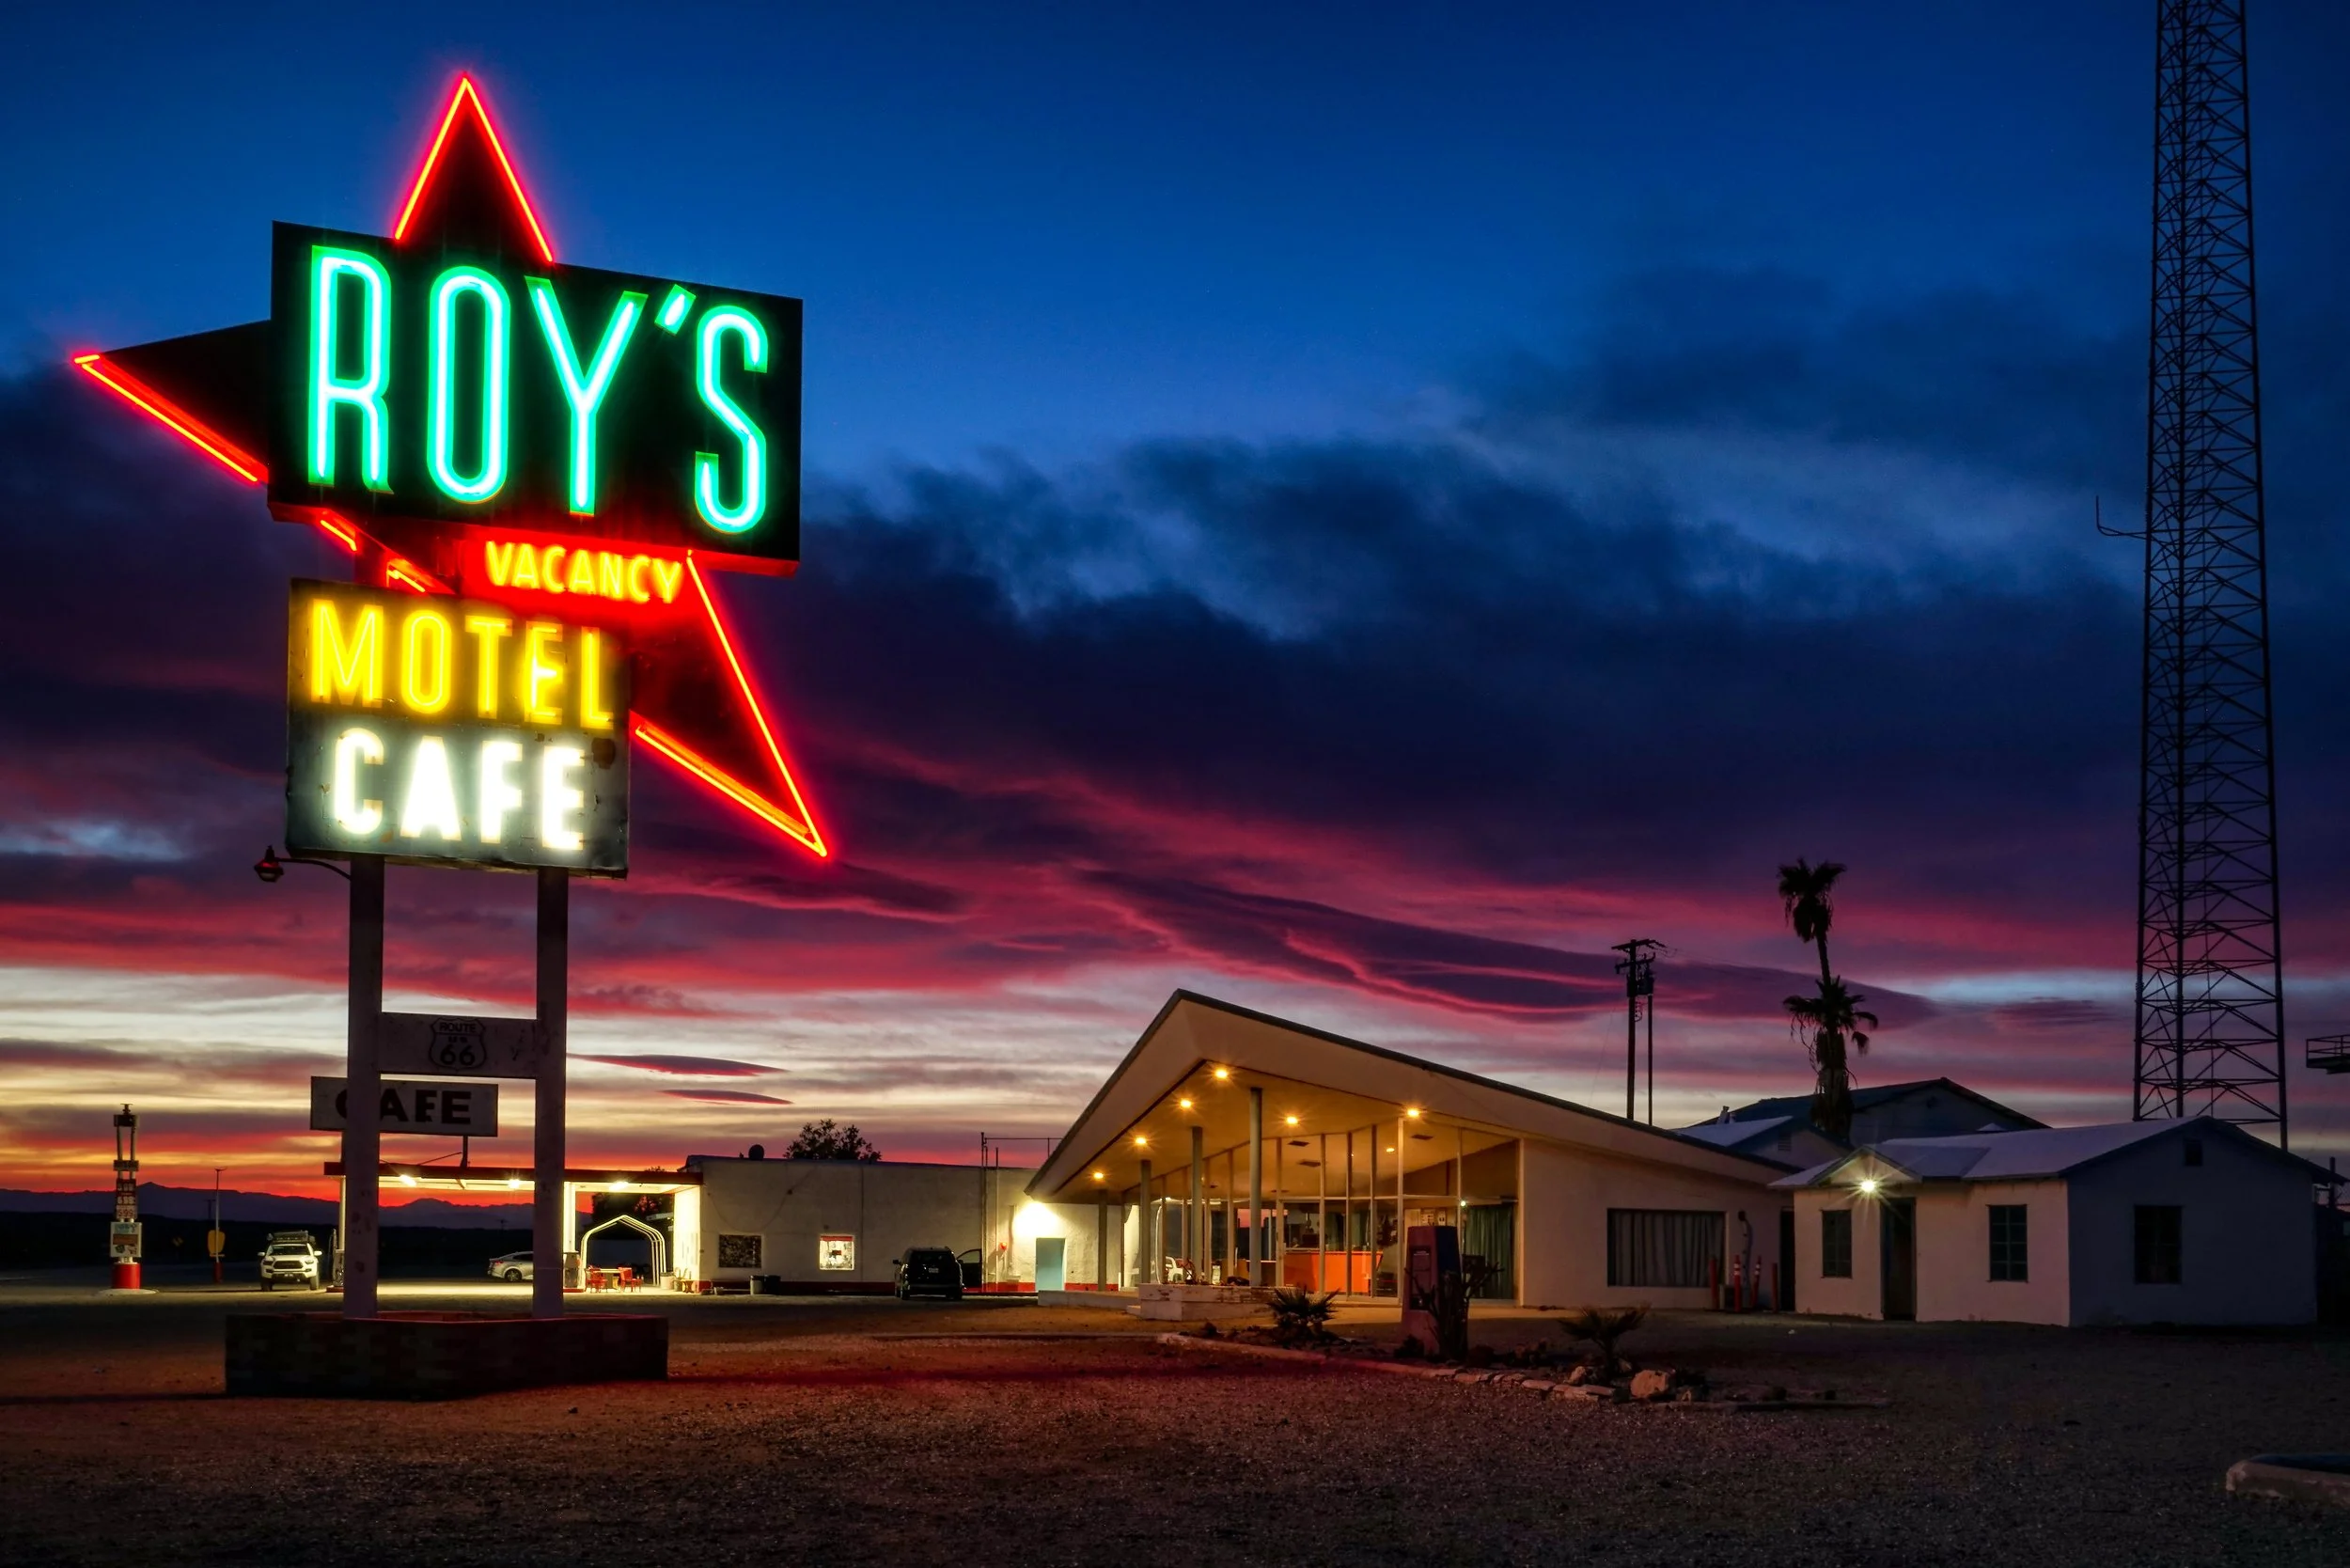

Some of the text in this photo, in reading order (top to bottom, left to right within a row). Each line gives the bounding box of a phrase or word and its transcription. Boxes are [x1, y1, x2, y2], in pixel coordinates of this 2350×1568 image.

[307, 244, 768, 534] ROY'S
[484, 540, 682, 603] VACANCY
[309, 597, 615, 731] MOTEL
[331, 727, 587, 853] CAFE
[440, 1022, 477, 1032] ROUTE
[440, 1044, 476, 1066] 66
